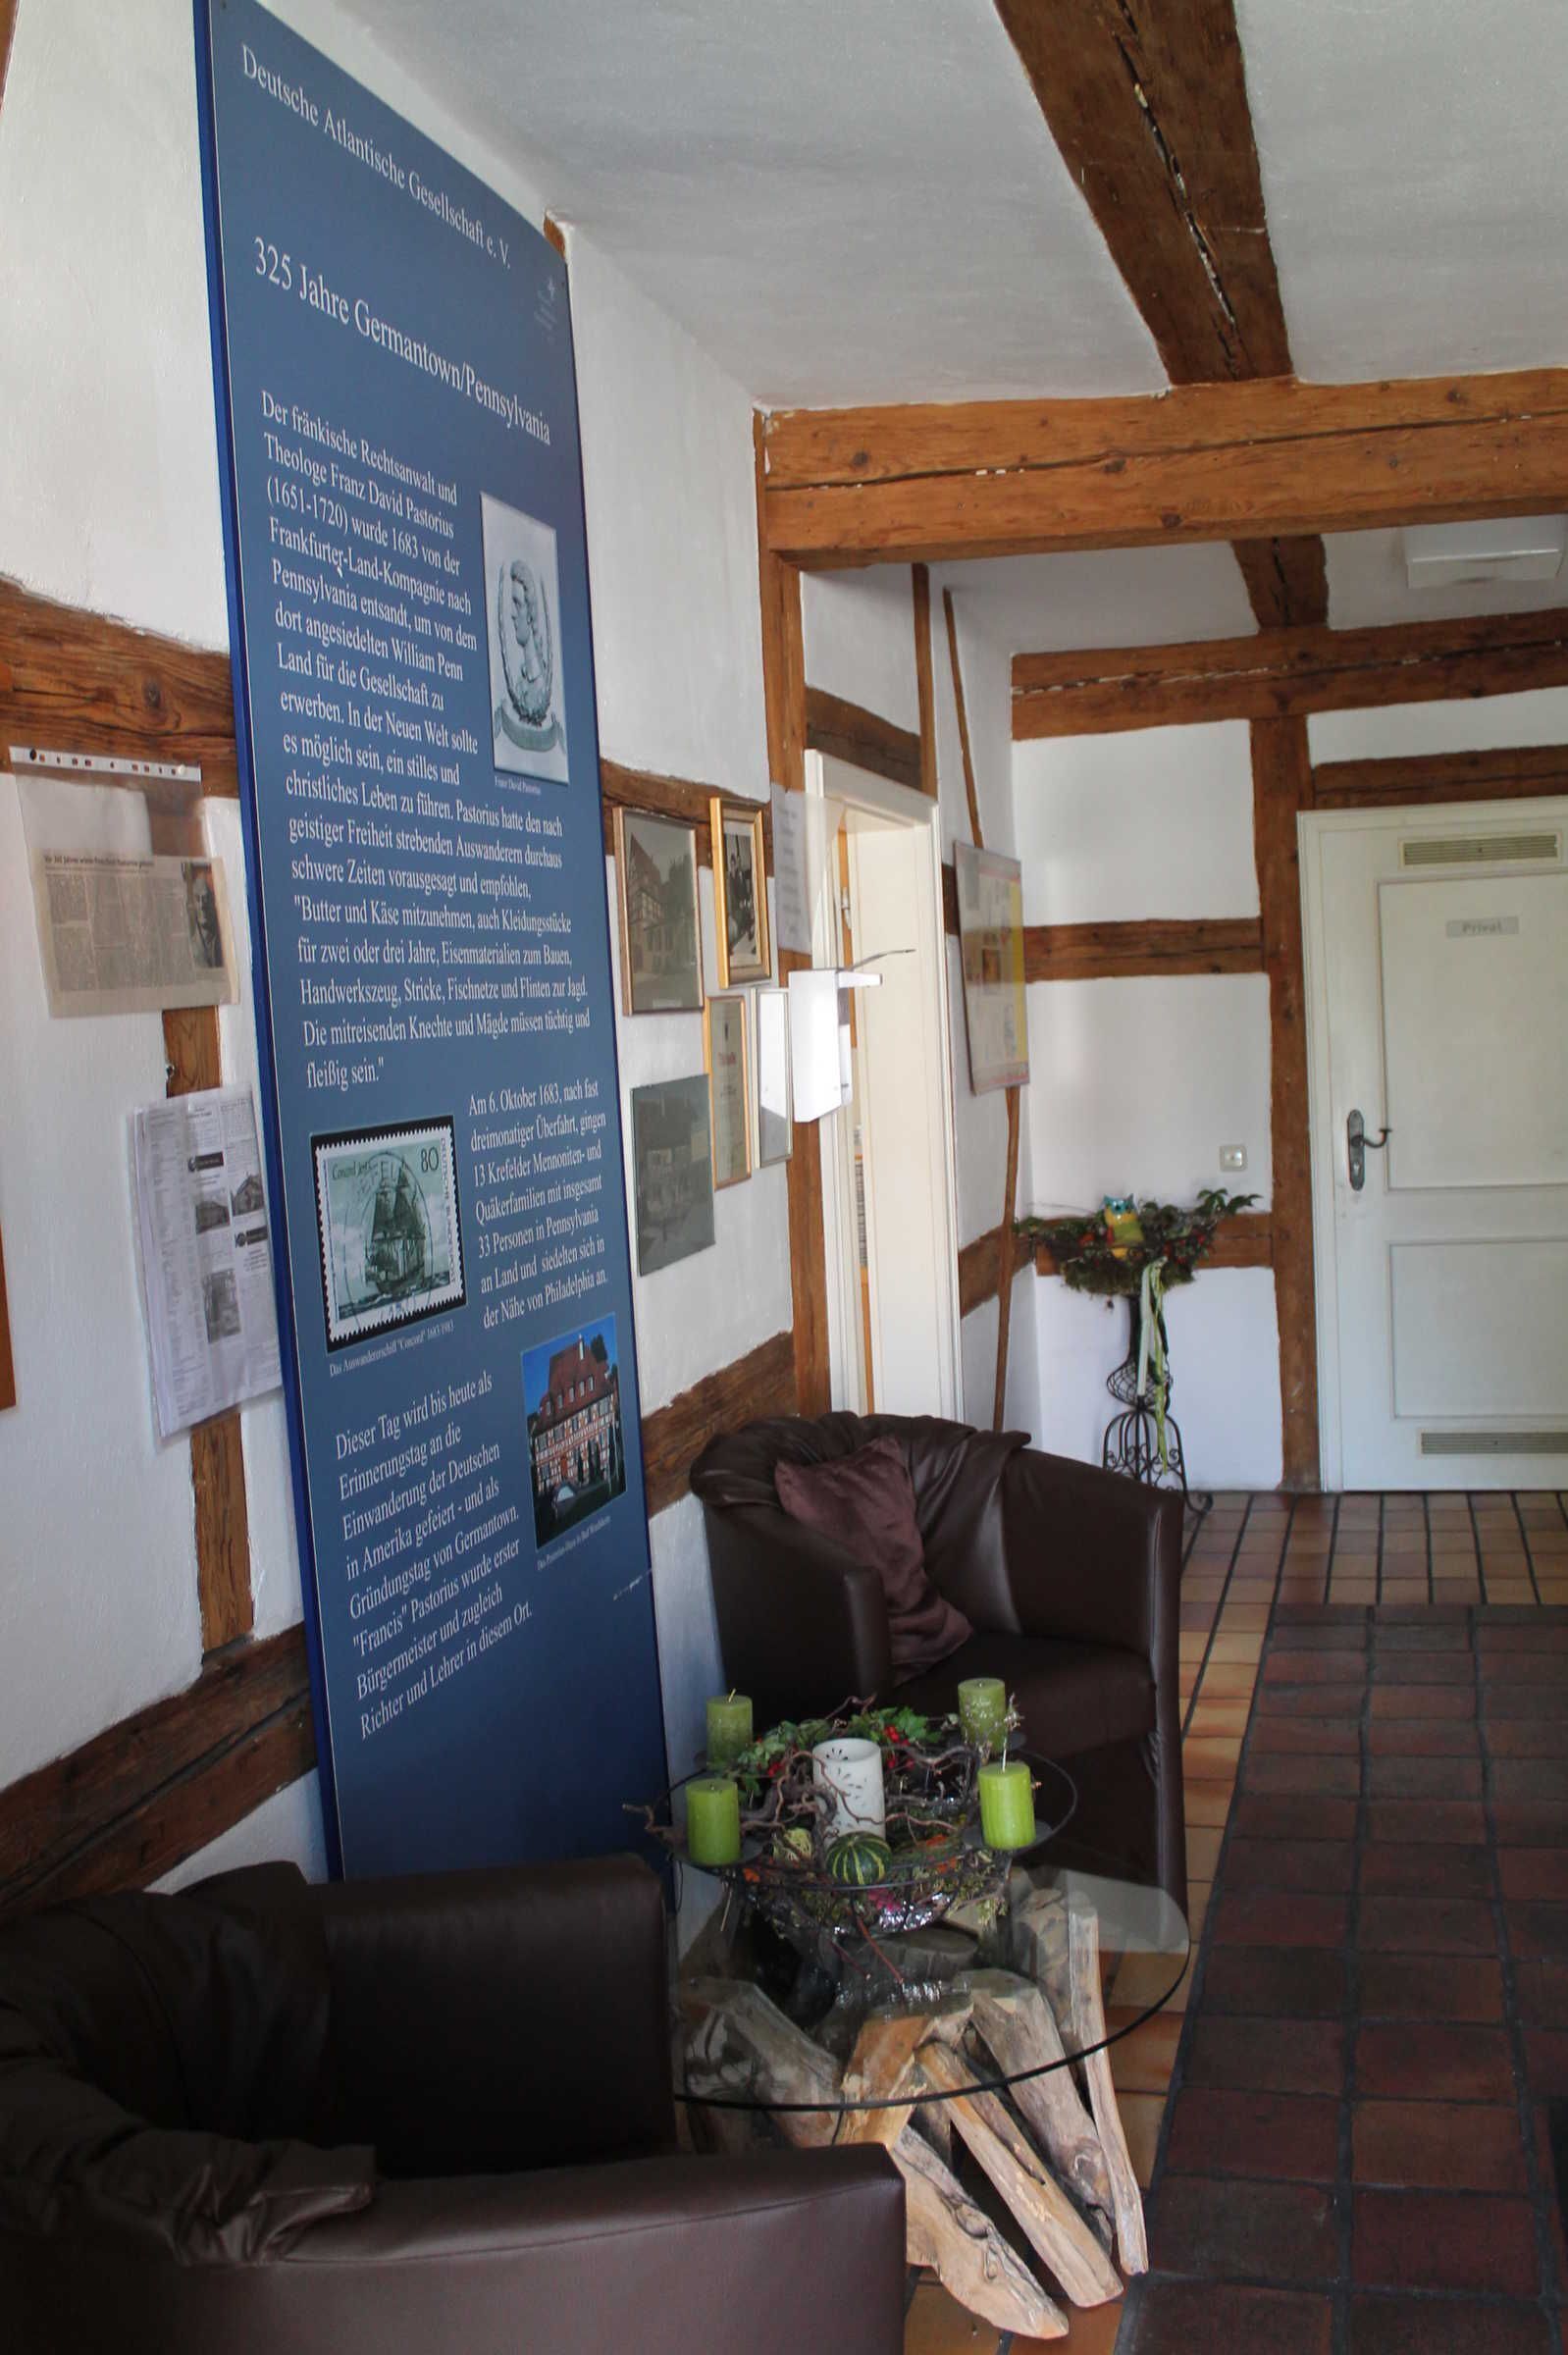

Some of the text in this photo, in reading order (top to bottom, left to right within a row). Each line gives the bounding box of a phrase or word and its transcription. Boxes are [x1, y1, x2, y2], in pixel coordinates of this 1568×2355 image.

[242, 44, 318, 127] Deutsche
[324, 109, 405, 188] Atlantische
[409, 171, 484, 248] Gesellschaft
[487, 236, 497, 257] e.
[254, 236, 291, 290] 325
[299, 264, 349, 325] Jahre
[354, 299, 550, 445] Germantown/Pennsylvania
[262, 391, 457, 506] Der fränkische Rechtsanwalt und
[264, 432, 454, 539] Theologe Franz David Pastorius
[267, 476, 460, 576] (1651-1720) wurde 1683 von der
[270, 516, 471, 615] Frankfurter-Land-Kompagnie nach
[273, 557, 477, 652] Pennsylvania entsandt, um von dem
[275, 601, 463, 681] dort angesiedelten William Penn
[278, 642, 444, 710] Land für die Gesellschaft zu
[281, 691, 478, 755] erwerben. In der Neuen Welt sollte
[284, 734, 460, 785] es möglich sein, ein stilles und
[286, 769, 453, 819] christliches Leben zu führen.
[289, 811, 453, 856] geistiger Freiheit strebenden
[291, 853, 531, 901] schwere Zeiten vorausgesagt und empfohlen,
[294, 895, 499, 932] "Butter und Käse mitzunehmen, auch
[298, 936, 521, 966] für zwei oder drei Jahre, Eisenmaterialien
[300, 975, 588, 1009] Handwerkszeug, Stricke, Fischnetze und Jagd.
[303, 1013, 474, 1046] Die mitreisenden Knechte und
[307, 1057, 384, 1091] fleißig sein."
[469, 1077, 599, 1117] Am 6. Oktober fast
[421, 1147, 440, 1173] 80
[471, 1123, 534, 1152] dreimonatiger
[580, 1111, 606, 1136] gingen
[474, 1138, 601, 1187] 13 Krefelder Mennoniten- und
[476, 1174, 601, 1227] Quäkerfamilien insgesamt
[479, 1204, 599, 1259] 33 Personen in Pennsylvania
[481, 1245, 578, 1294] an Land und siedelten
[484, 1269, 595, 1329] der Nähe von Philadelphia
[336, 1370, 493, 1460] Dieser Tag wird bis heute als
[340, 1422, 461, 1500] Erinnerungstag an die
[342, 1443, 499, 1541] Einwanderung der Deutschen
[346, 1476, 499, 1581] in Amerika gefeiert als
[350, 1558, 431, 1619] Gründungstag
[454, 1506, 519, 1554] Germantown.
[353, 1603, 407, 1656] "Francis"
[411, 1578, 459, 1623] Pastorius
[461, 1554, 492, 1589] wurde
[494, 1539, 519, 1568] erster
[357, 1582, 502, 1700] Bürgermeister und zugleich
[361, 1601, 532, 1740] Richter und Lehrer in diesem Ort.
